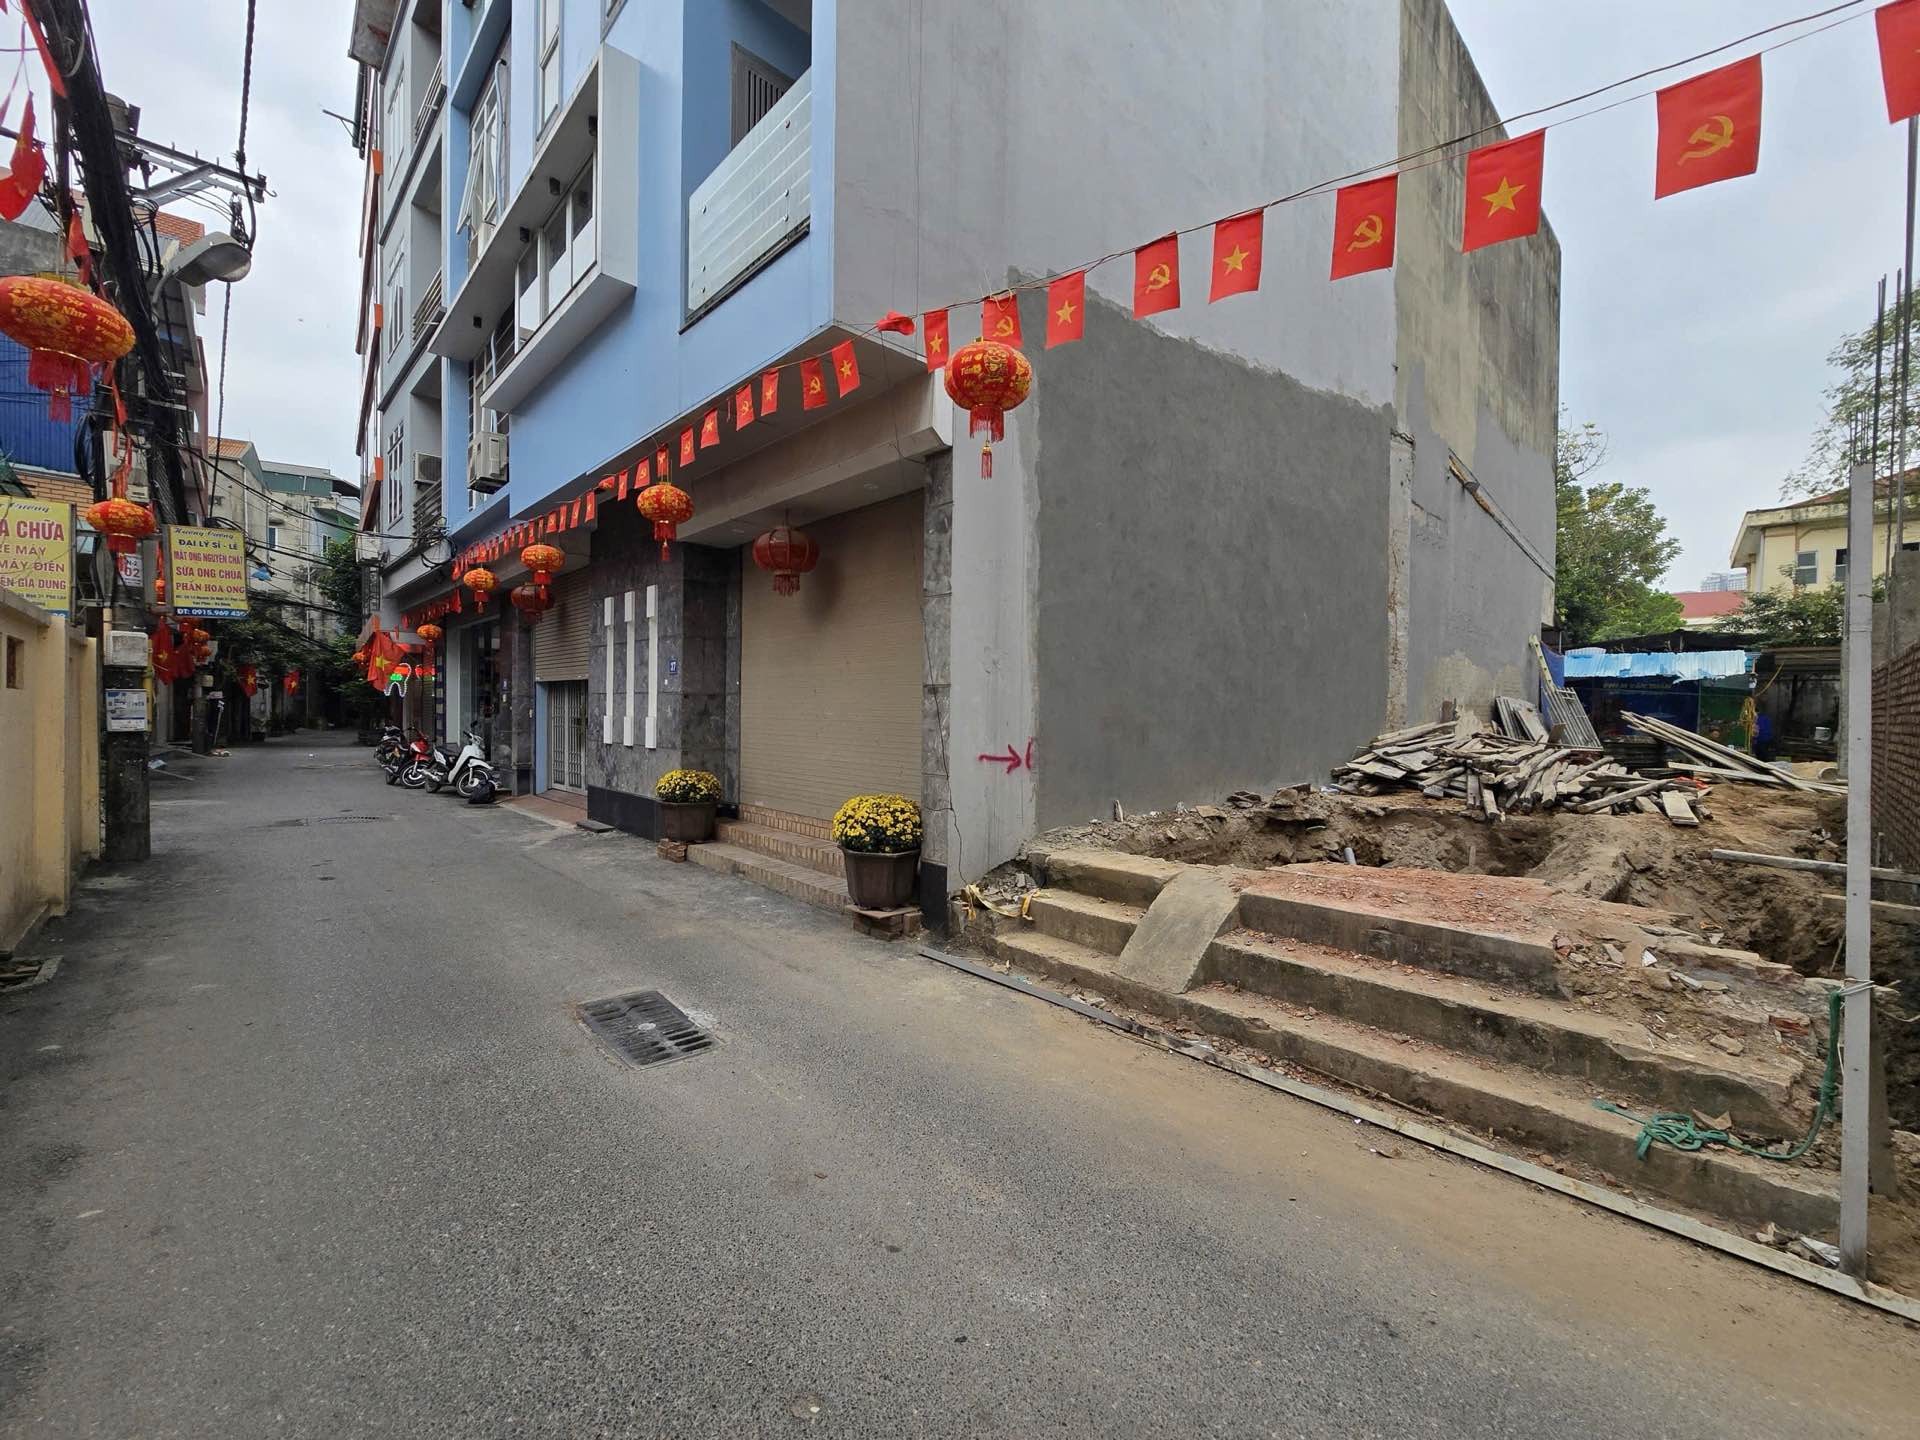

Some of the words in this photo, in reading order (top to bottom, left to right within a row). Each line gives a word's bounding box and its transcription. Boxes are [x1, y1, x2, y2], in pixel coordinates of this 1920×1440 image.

[16, 519, 65, 541] CHỮA
[199, 539, 209, 548] LÝ
[16, 543, 46, 556] MÁY
[33, 559, 65, 574] ĐIỆN
[197, 567, 216, 578] ONG
[18, 578, 35, 589] GIA
[204, 583, 224, 593] HOA
[226, 584, 246, 594] ONG
